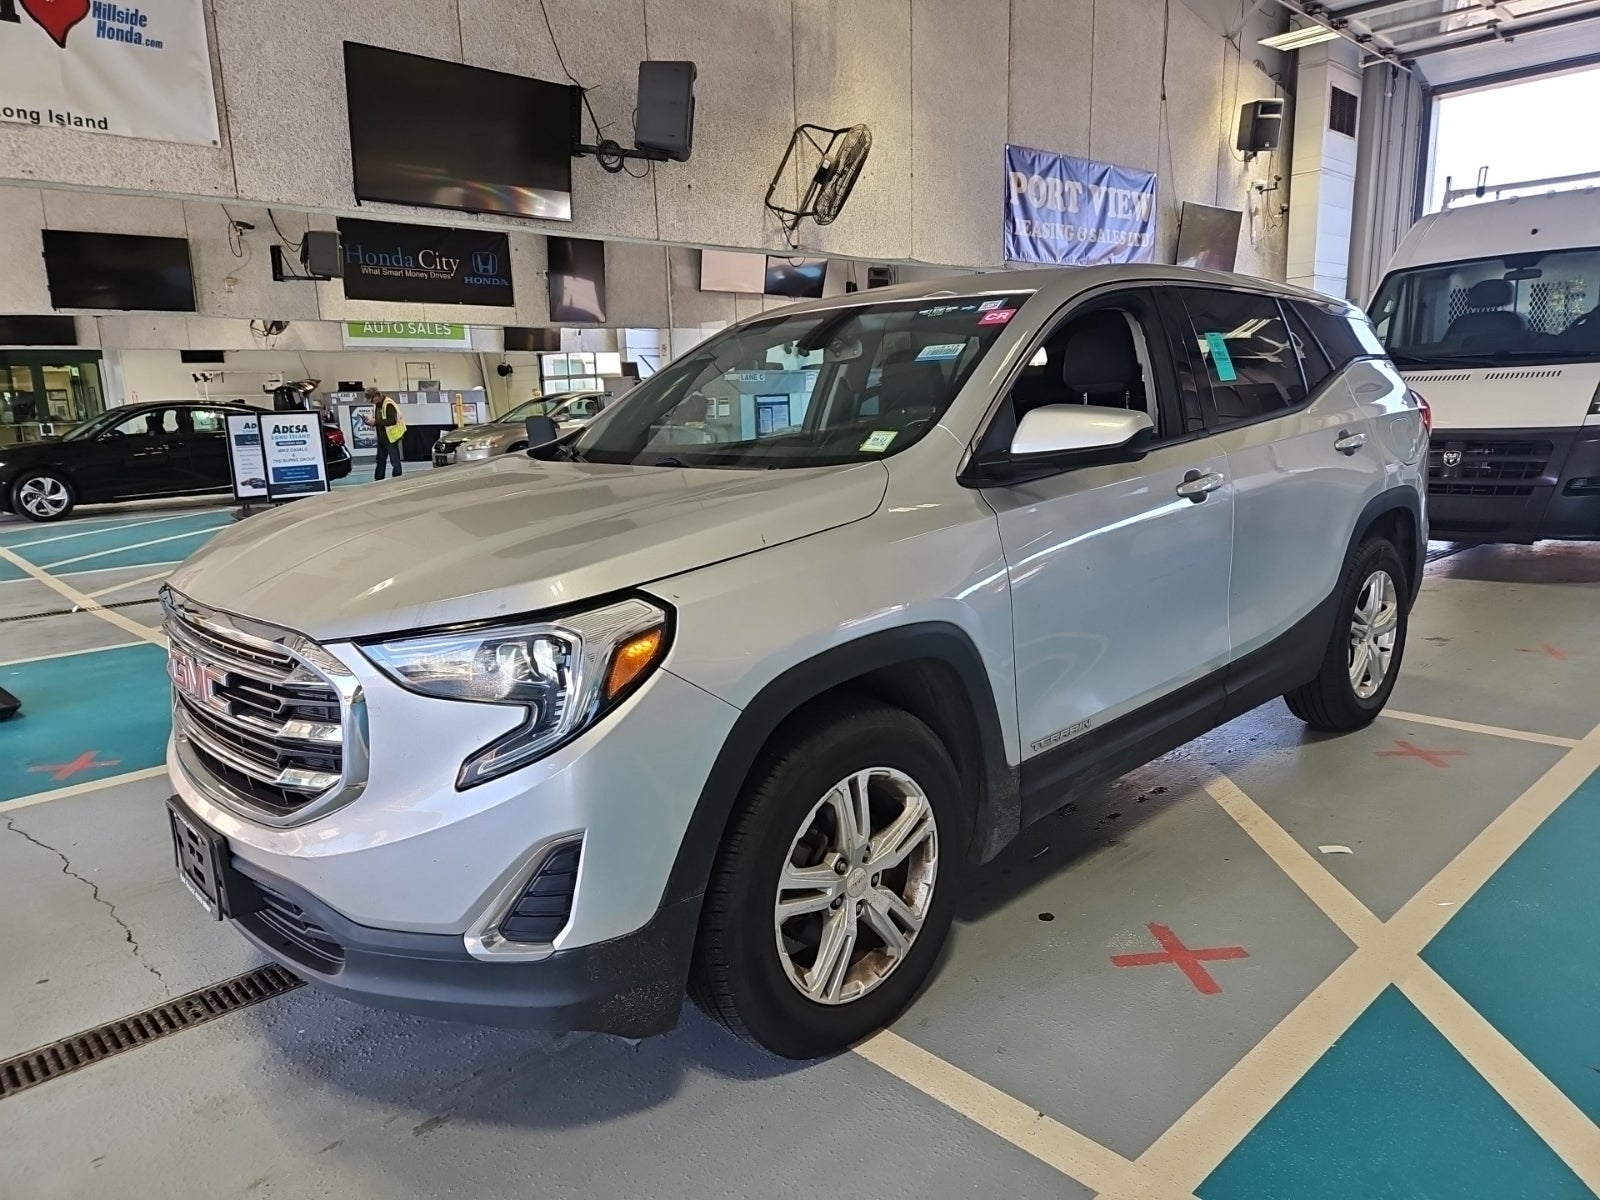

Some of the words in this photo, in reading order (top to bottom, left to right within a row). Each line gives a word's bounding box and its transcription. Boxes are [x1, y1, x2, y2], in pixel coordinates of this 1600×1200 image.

[92, 1, 148, 28] Hillside
[96, 20, 163, 49] Honda.com
[0, 106, 41, 125] ong
[48, 109, 109, 130] Island
[1009, 171, 1083, 213] PORT
[1089, 184, 1153, 223] VIEW
[1015, 218, 1074, 241] LEASING
[1077, 226, 1087, 241] &
[1089, 228, 1127, 246] SALES
[1127, 231, 1150, 247] LTD
[345, 243, 413, 267] Honda
[418, 250, 460, 276] City
[361, 266, 381, 276] What
[382, 268, 403, 277] Smart
[405, 269, 428, 279] Money
[430, 271, 451, 280] Drives
[464, 276, 509, 286] HONDA
[363, 321, 403, 334] AUTO
[408, 322, 452, 336] SALES
[985, 312, 1010, 321] CR
[740, 373, 758, 381] LANE
[272, 424, 308, 434] ADESA
[170, 652, 232, 715] GMC
[1031, 719, 1092, 752] TERRAIN
